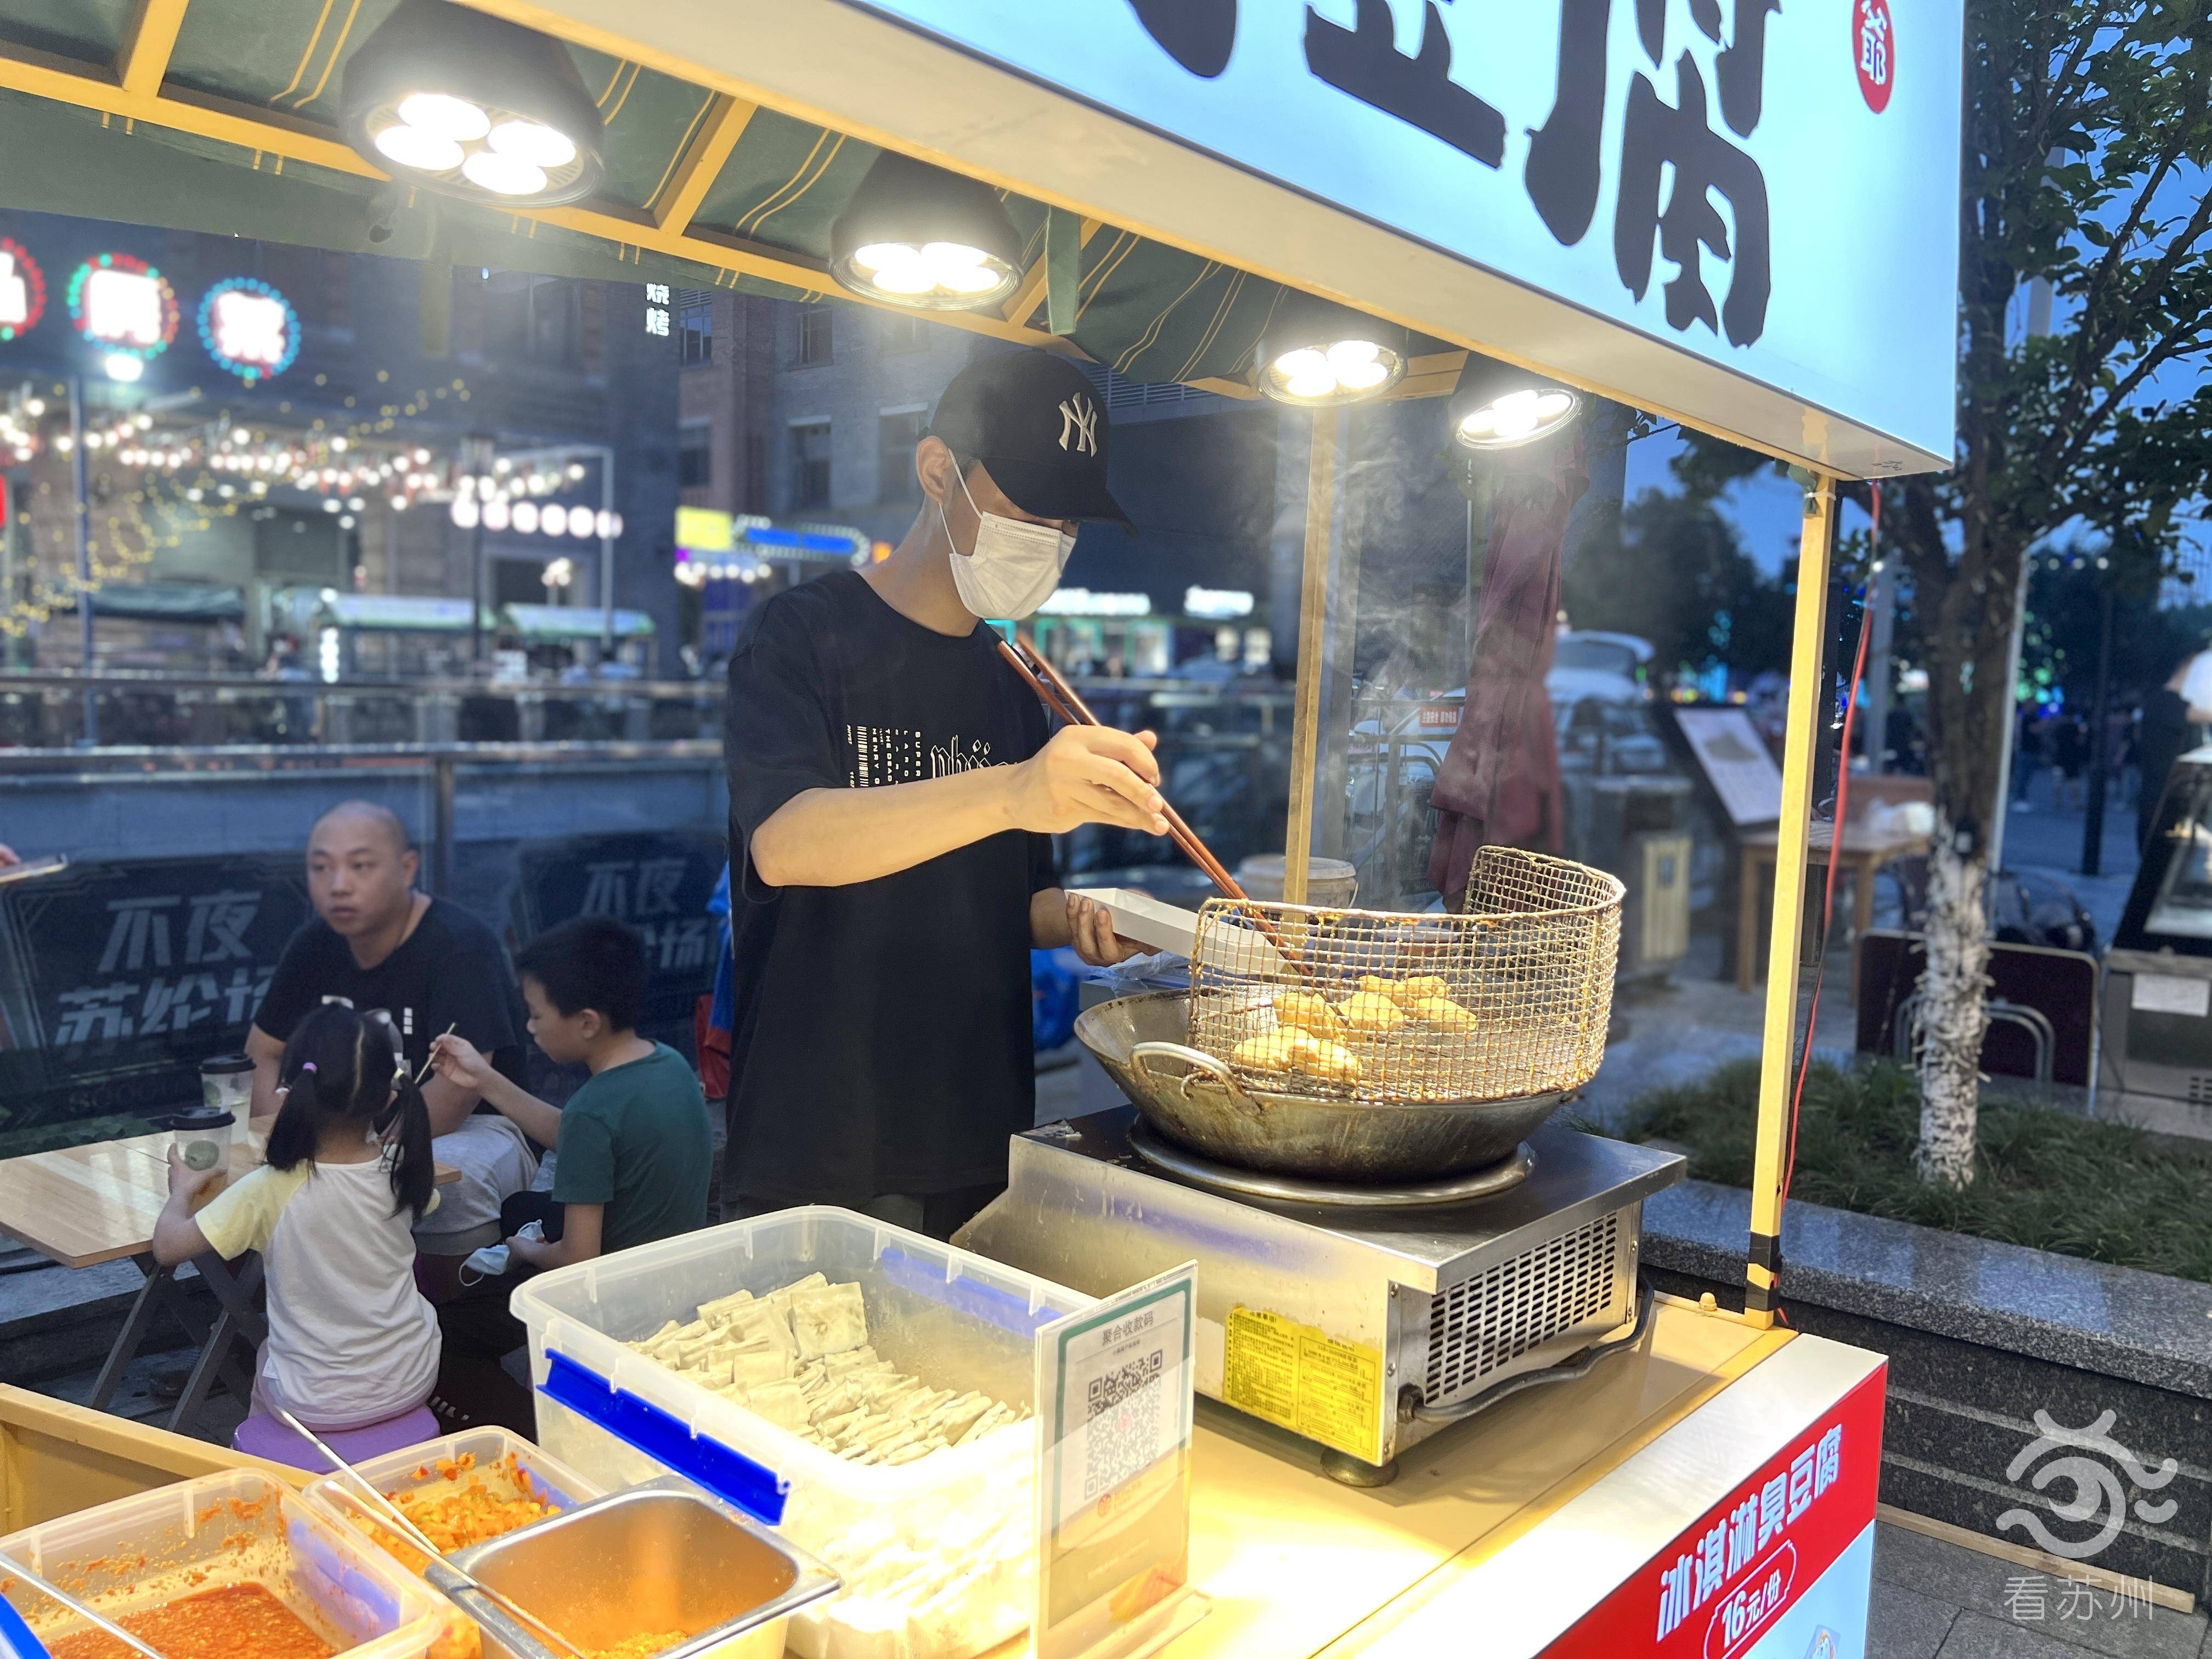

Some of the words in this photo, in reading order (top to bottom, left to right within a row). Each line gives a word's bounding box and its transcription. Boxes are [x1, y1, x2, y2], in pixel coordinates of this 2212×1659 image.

[646, 283, 670, 336] 烧烤
[1058, 392, 1098, 458] NY
[97, 890, 262, 973] 不夜
[1102, 1310, 1154, 1346] 聚合收款码
[1656, 1424, 1842, 1643] 冰淇淋臭豆腐
[1722, 1568, 1781, 1649] 16元/份
